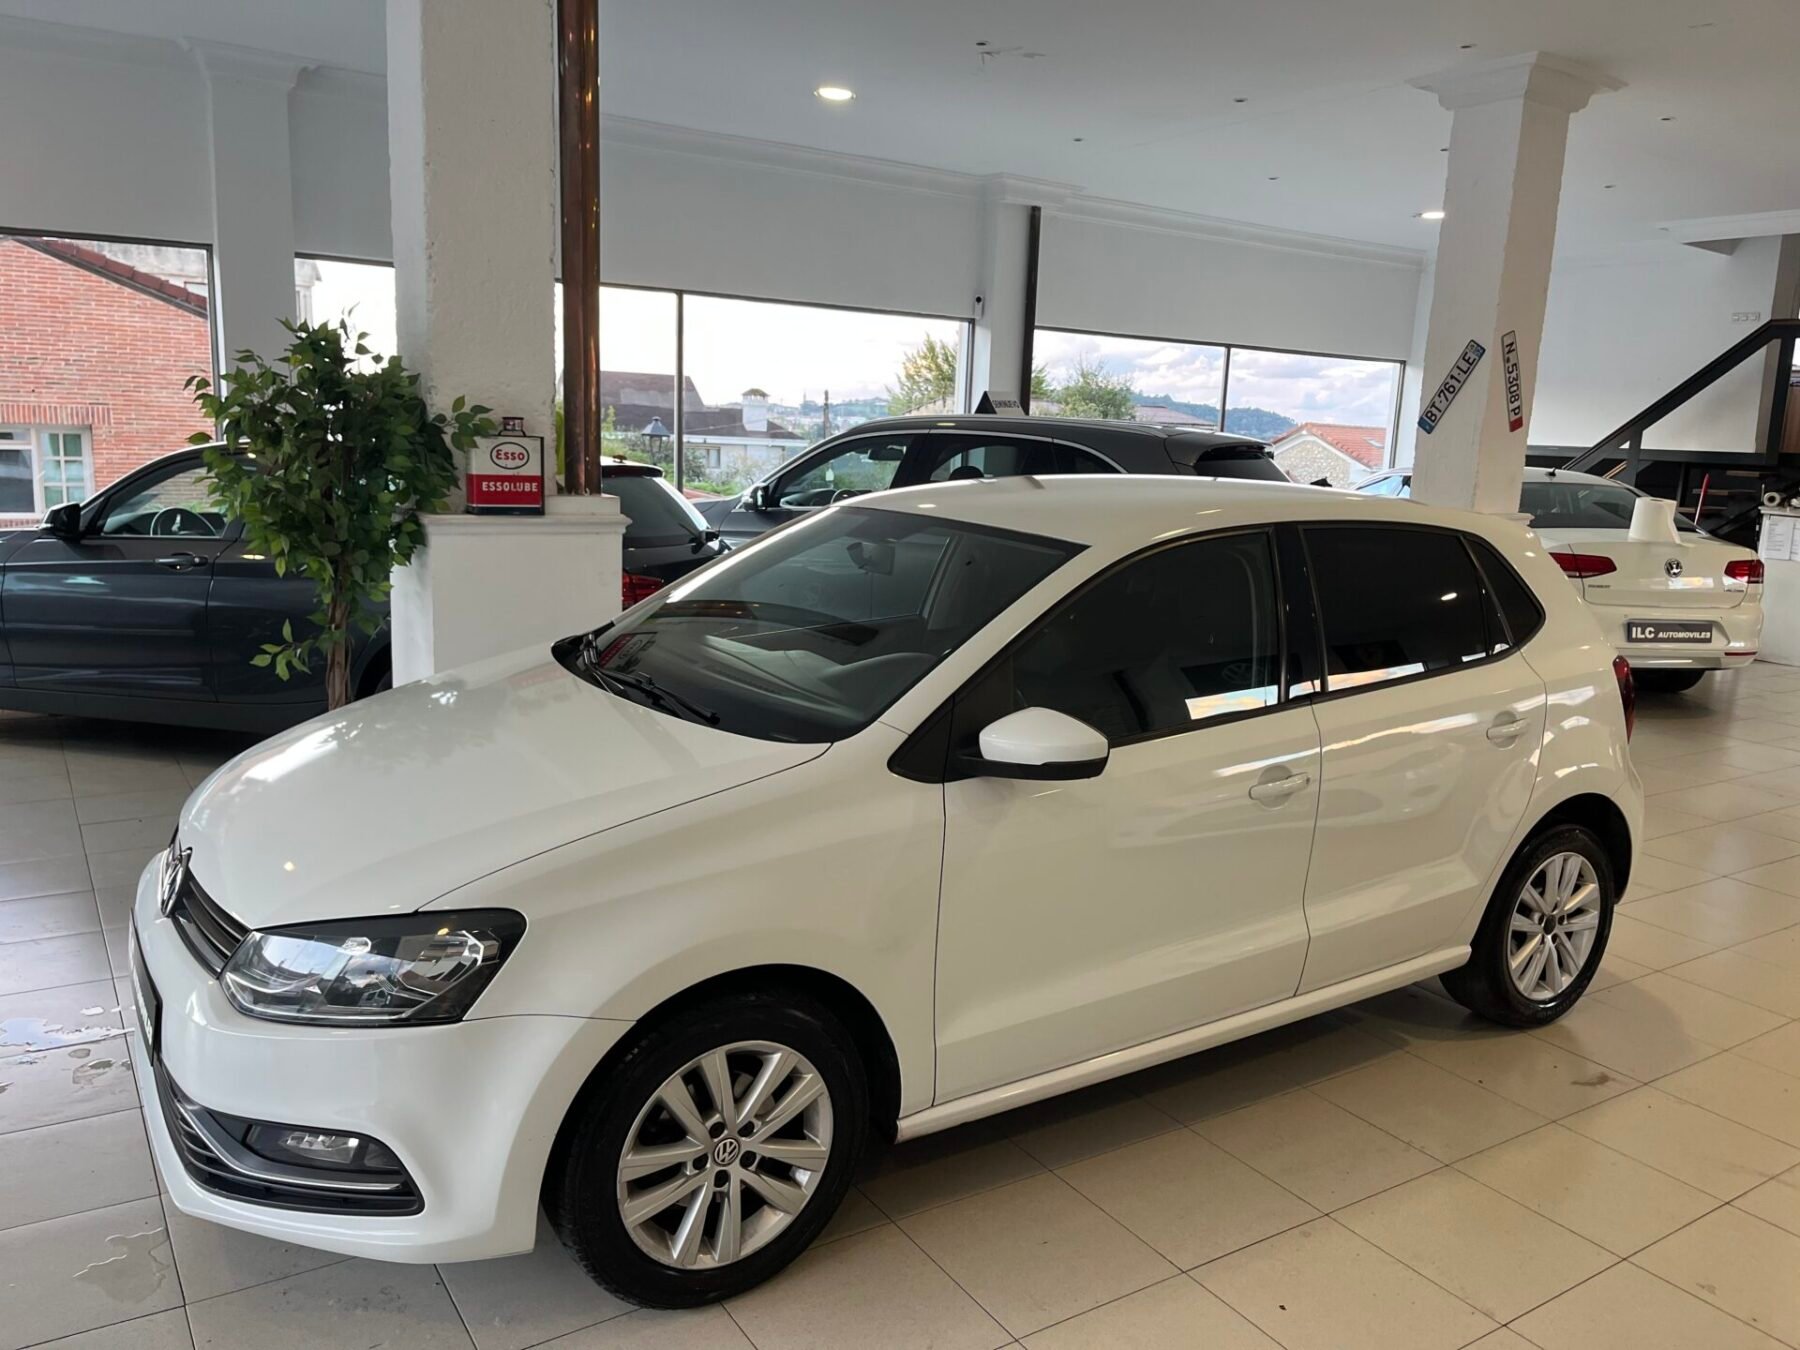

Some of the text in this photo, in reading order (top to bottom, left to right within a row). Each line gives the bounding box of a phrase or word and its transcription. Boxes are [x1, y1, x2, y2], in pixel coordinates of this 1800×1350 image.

[482, 482, 538, 491] ESSOLUBE
[1632, 626, 1711, 639] ILC AUTOMOVILES
